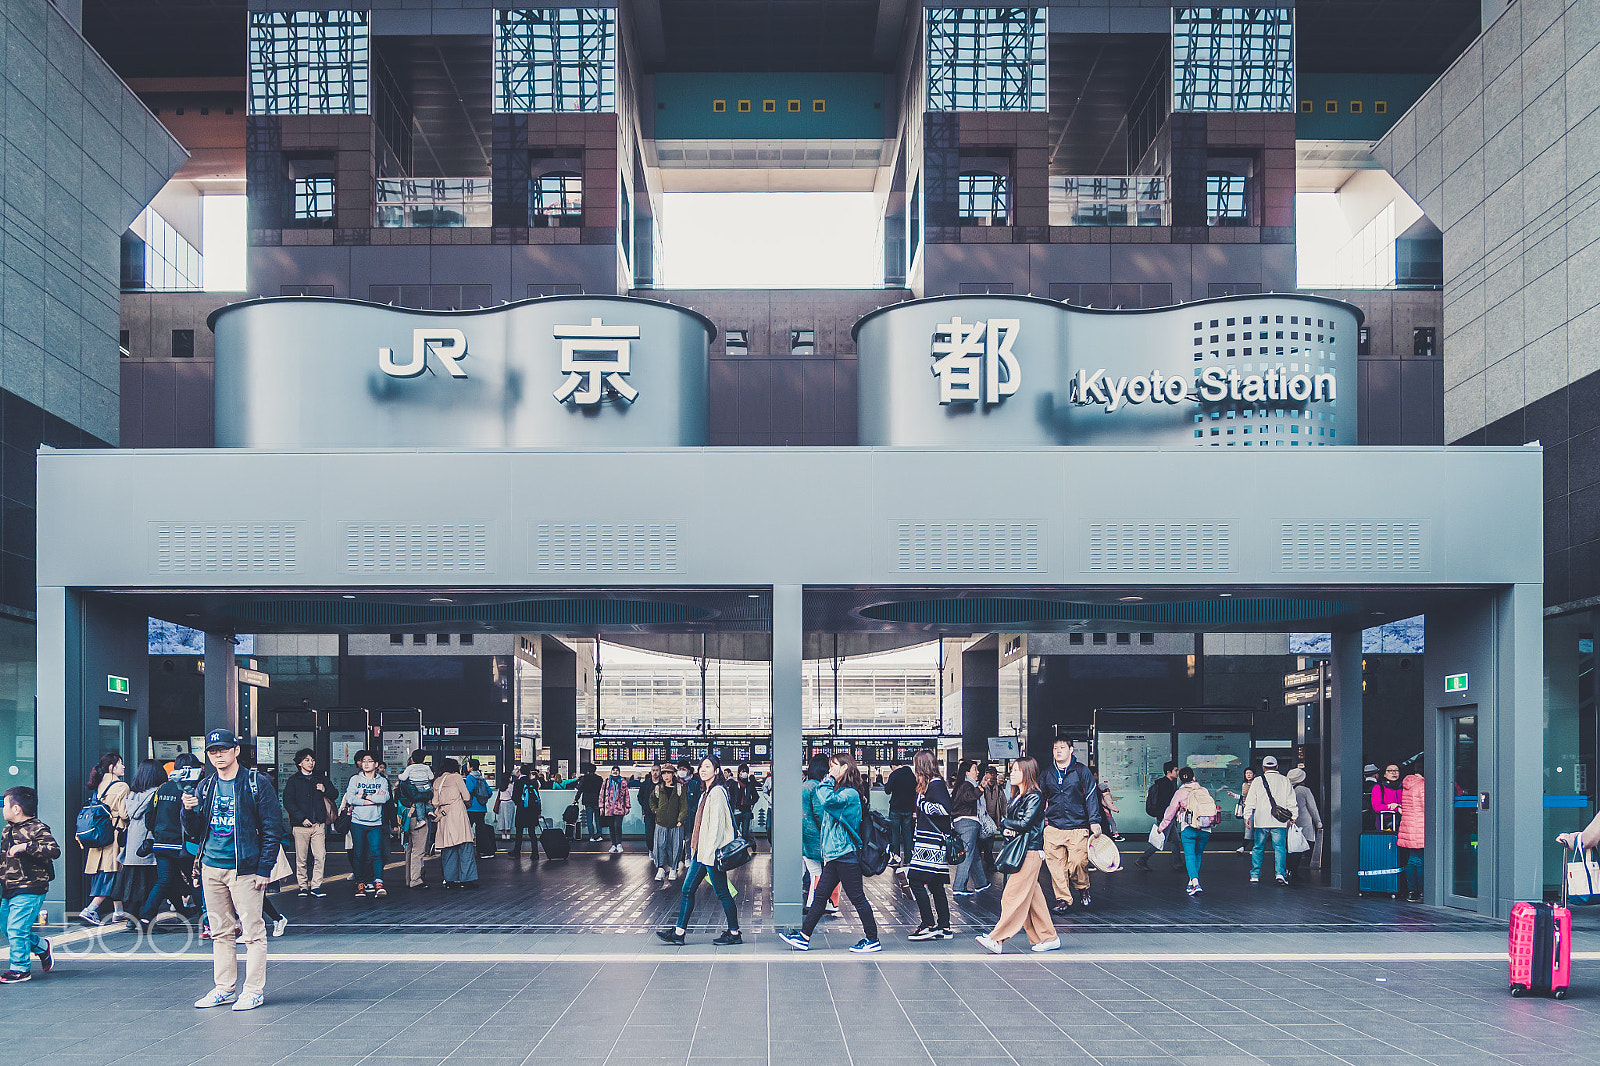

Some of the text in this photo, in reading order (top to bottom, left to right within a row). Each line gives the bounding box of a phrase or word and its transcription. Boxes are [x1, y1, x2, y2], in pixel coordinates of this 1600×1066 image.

[379, 328, 468, 378] JR
[553, 318, 640, 404] 京
[931, 317, 1021, 405] 都
[1077, 366, 1337, 412] Kyoto Station
